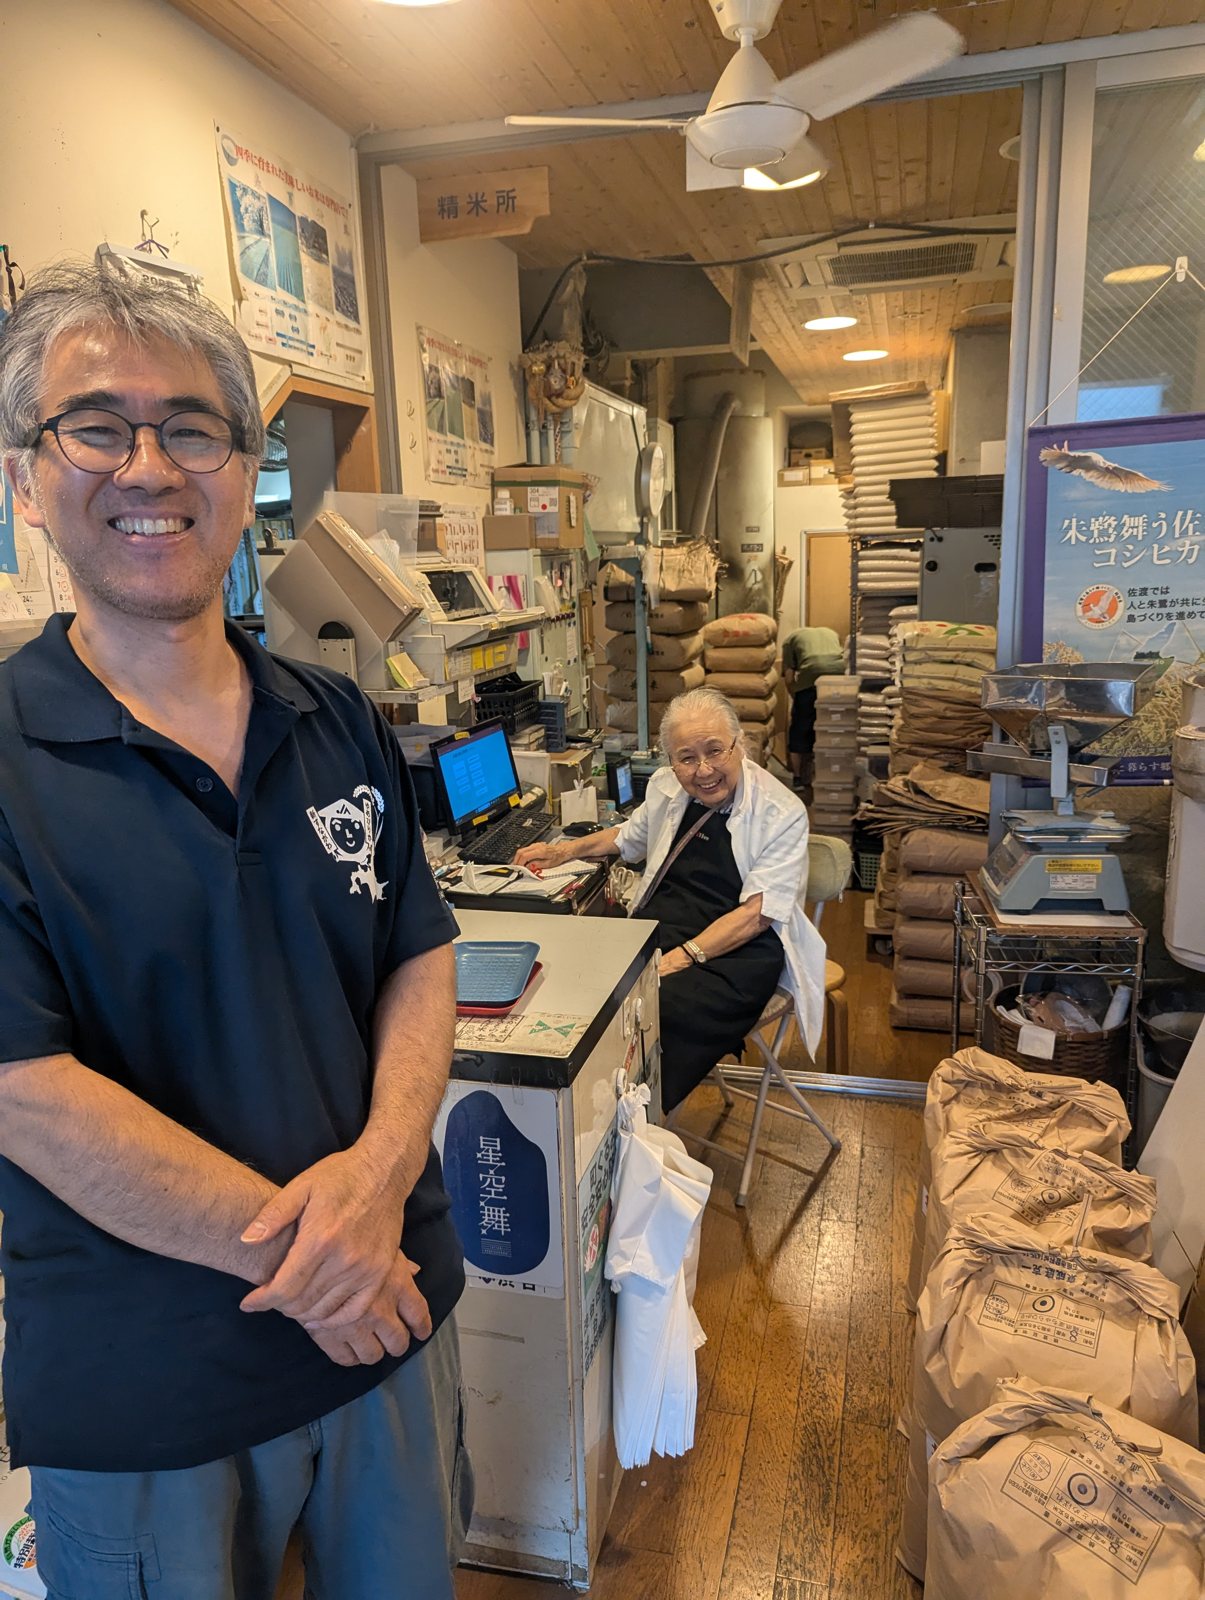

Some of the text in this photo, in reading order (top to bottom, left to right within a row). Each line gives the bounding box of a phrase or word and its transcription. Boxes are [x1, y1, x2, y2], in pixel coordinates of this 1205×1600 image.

[437, 188, 517, 220] 精米所
[1093, 540, 1200, 568] コシヒカ
[1127, 585, 1171, 598] 佐渡では
[477, 1136, 511, 1236] 星空舞
